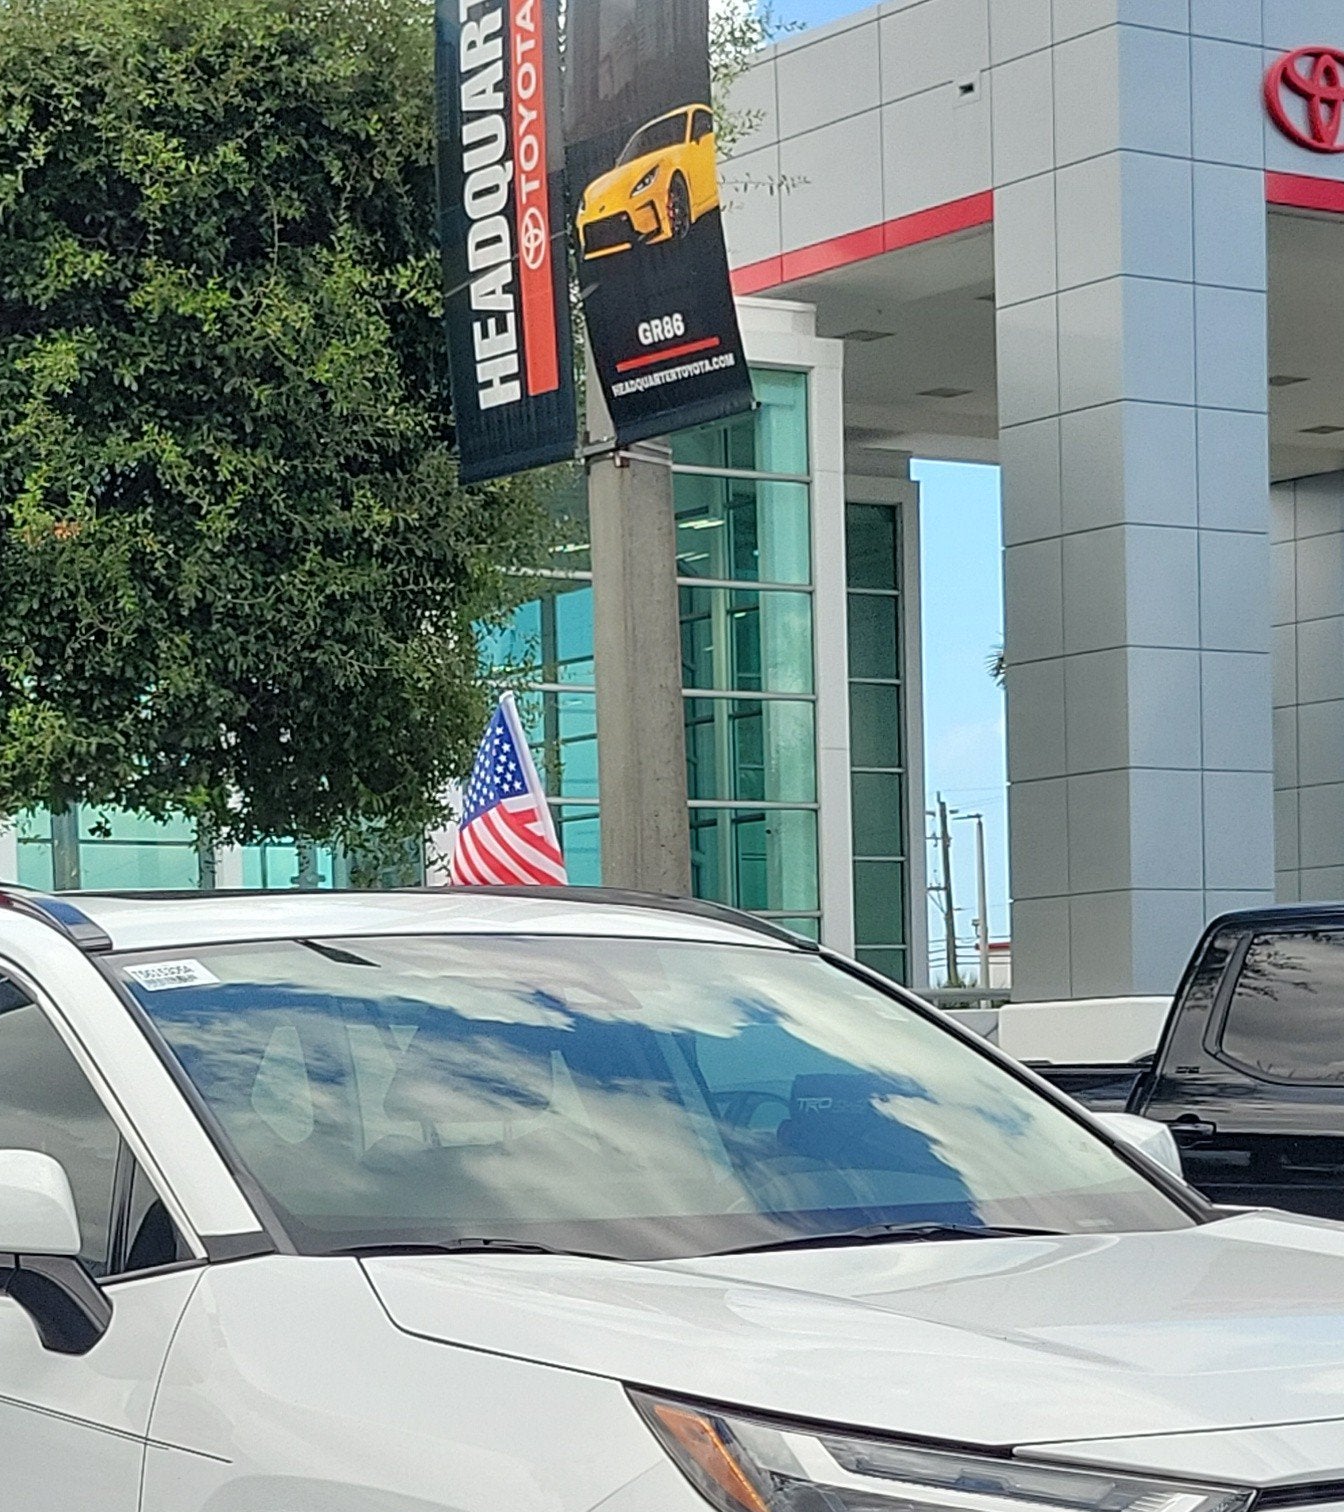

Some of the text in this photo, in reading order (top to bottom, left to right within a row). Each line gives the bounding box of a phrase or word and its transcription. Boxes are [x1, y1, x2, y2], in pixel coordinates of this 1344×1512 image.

[515, 0, 541, 200] TOYOTA
[638, 313, 685, 346] GR86
[611, 352, 736, 397] HEADQUARTERTOYOTA.COM
